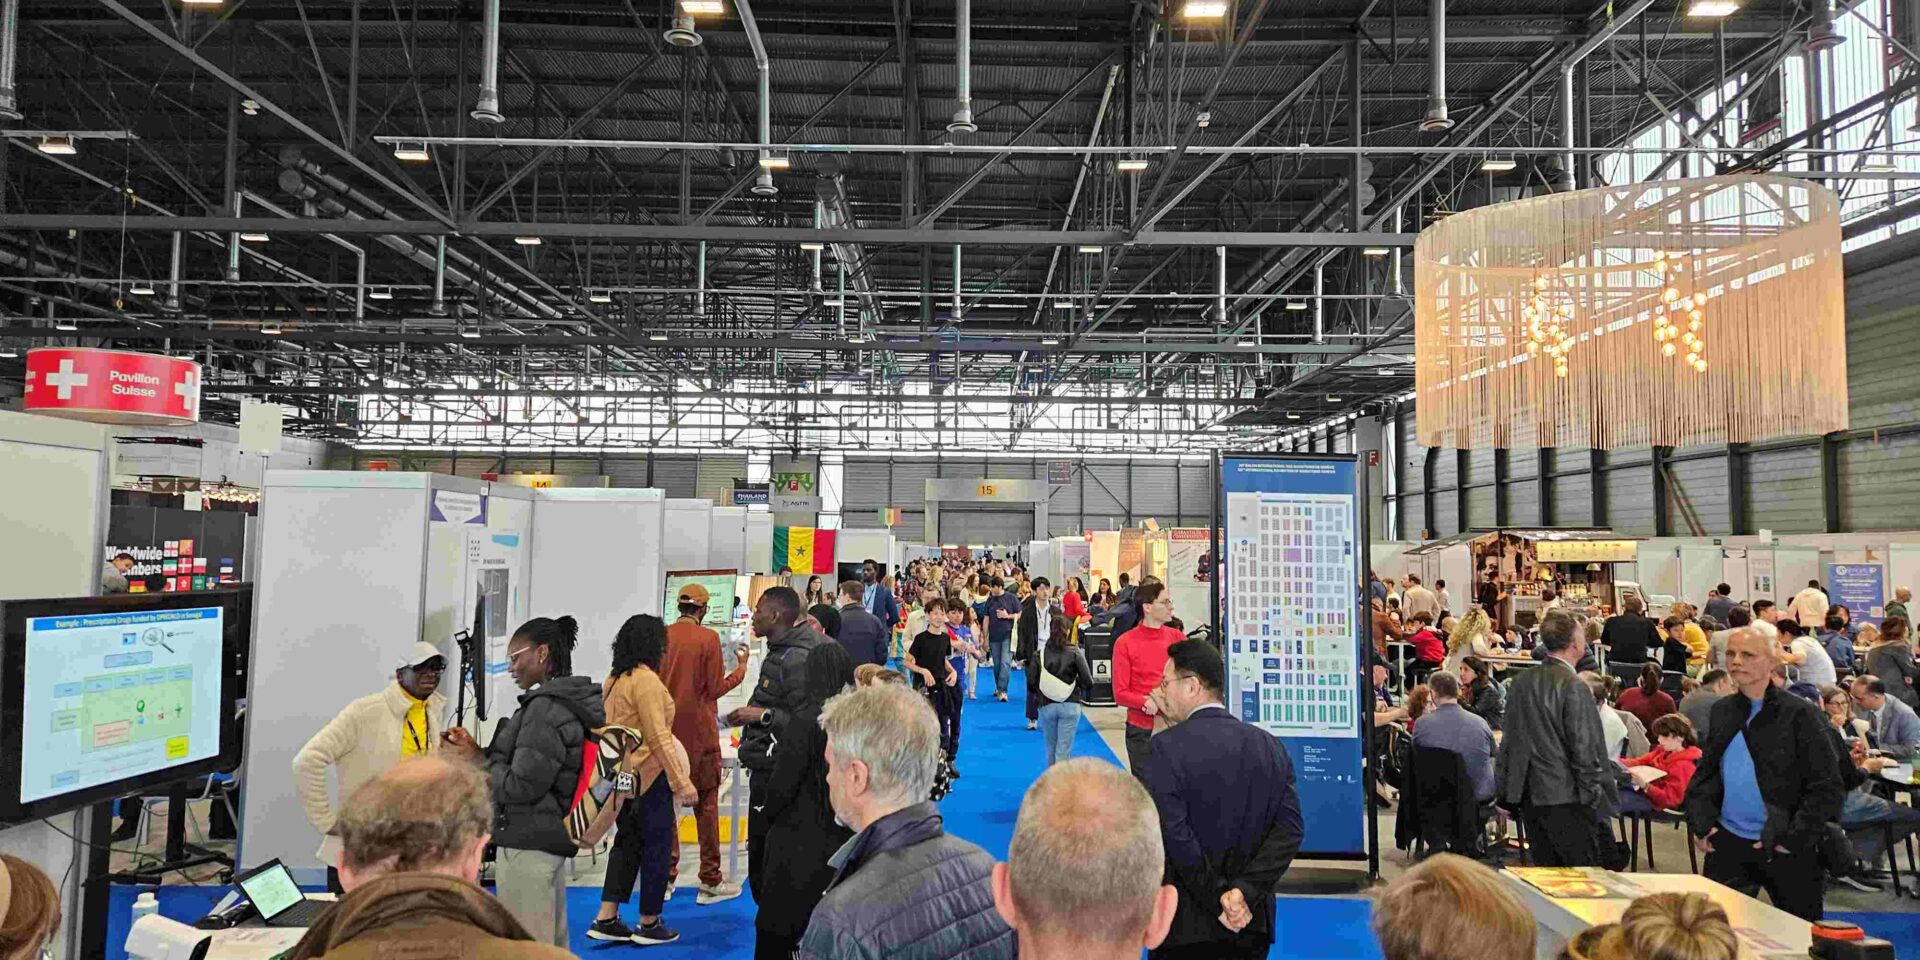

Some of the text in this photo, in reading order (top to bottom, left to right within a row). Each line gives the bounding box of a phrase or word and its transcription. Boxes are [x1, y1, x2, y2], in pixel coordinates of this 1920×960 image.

[110, 370, 160, 385] Pavillon
[112, 384, 156, 398] Suisse
[1370, 451, 1376, 462] F
[791, 481, 797, 489] F
[981, 485, 993, 495] 15
[121, 562, 162, 576] mbers
